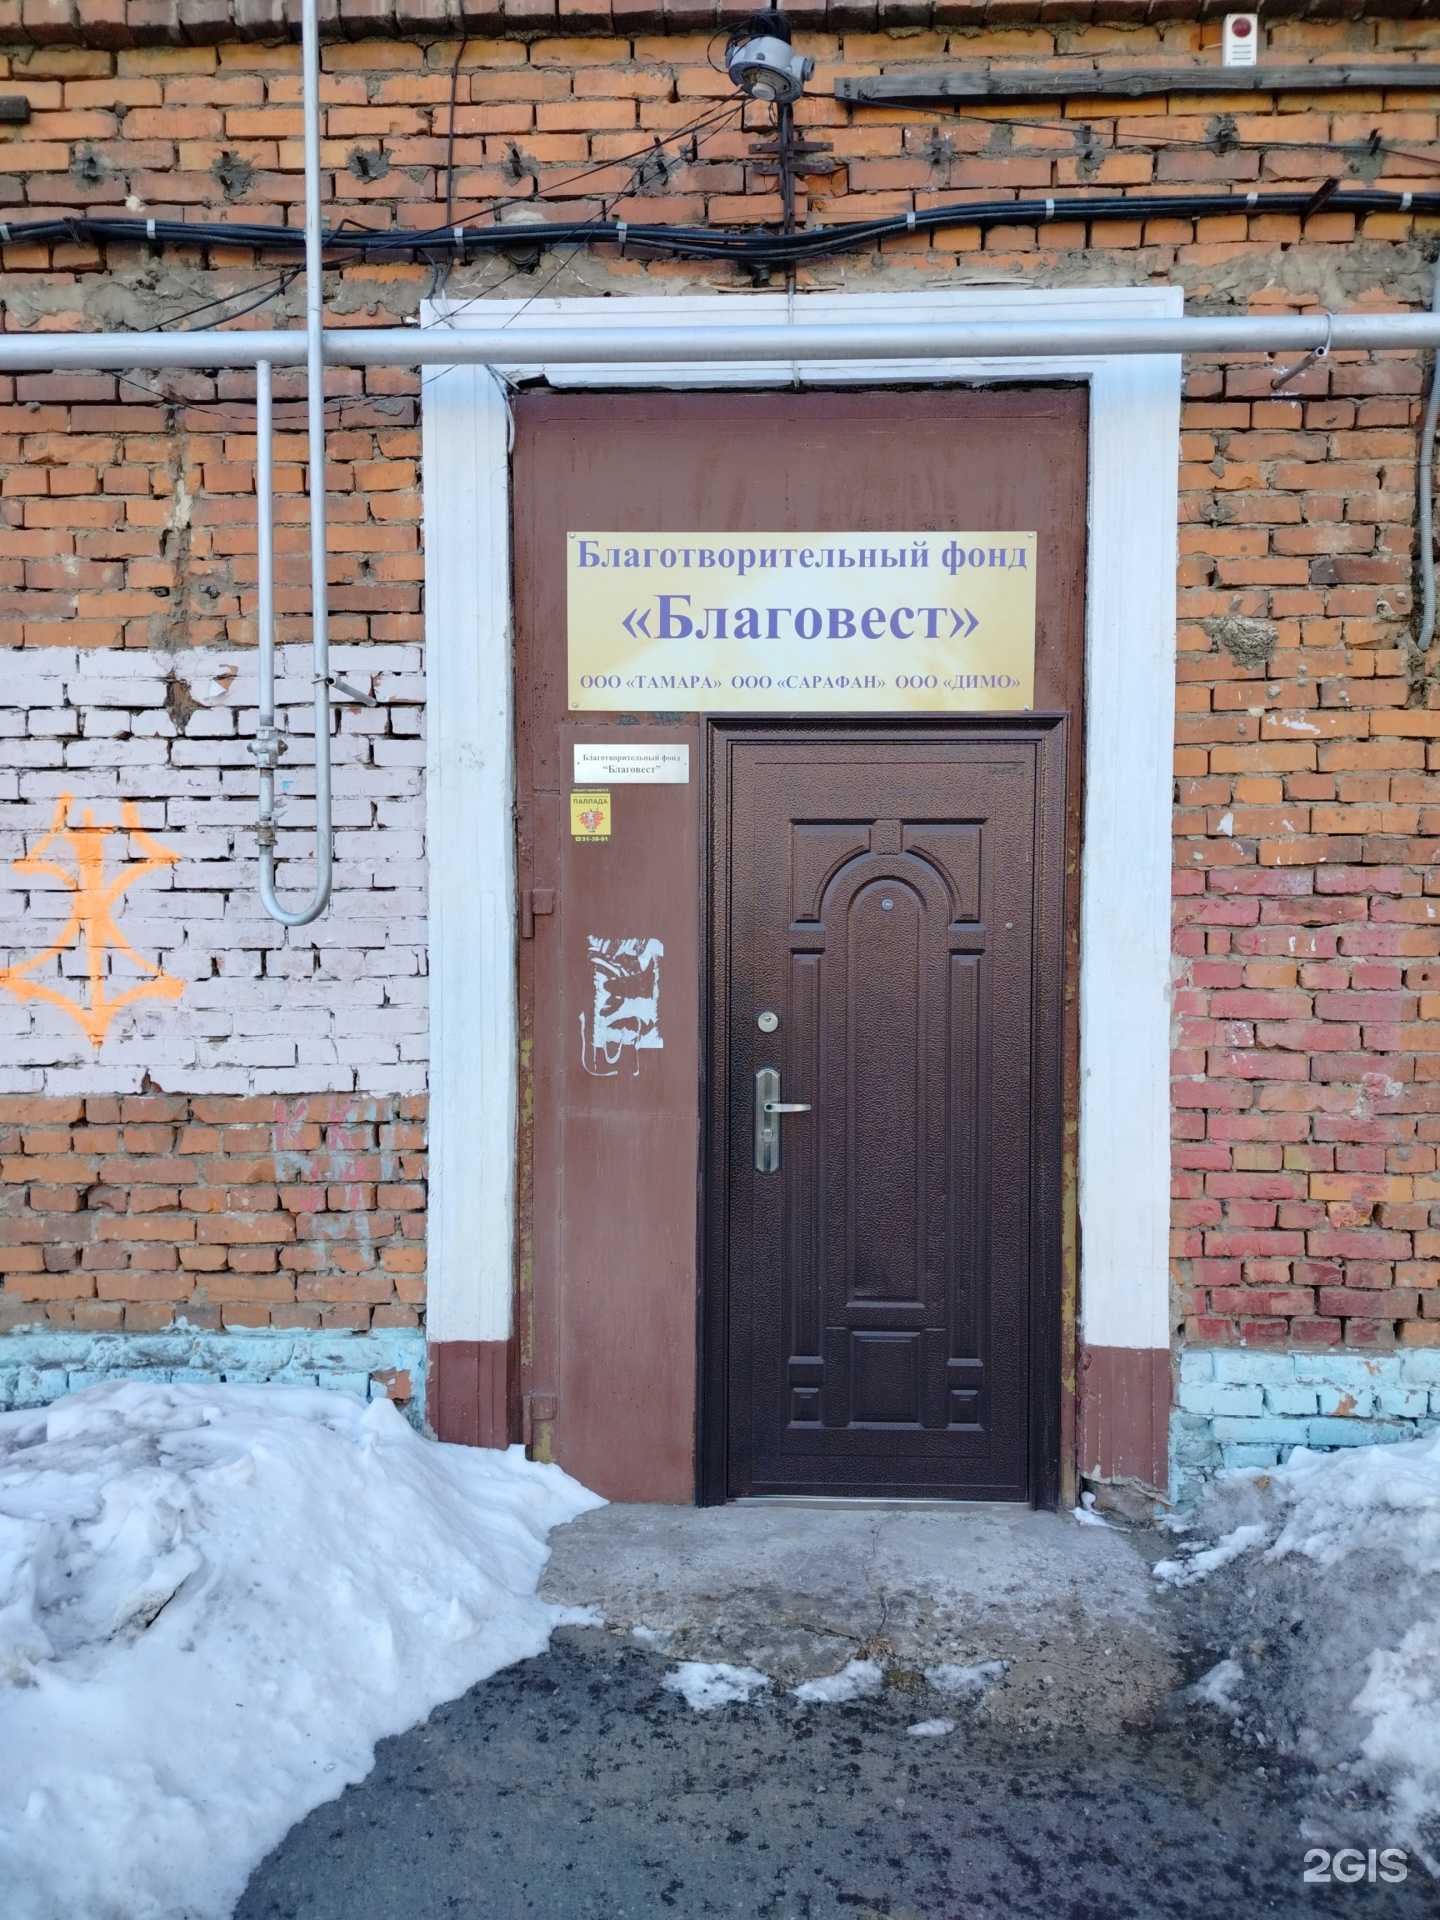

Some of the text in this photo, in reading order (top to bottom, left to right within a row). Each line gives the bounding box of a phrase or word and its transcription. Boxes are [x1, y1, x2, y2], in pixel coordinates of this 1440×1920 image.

[577, 541, 1028, 576] Благотворительный фонд
[622, 594, 980, 640] «Благовест»
[580, 674, 1021, 692] ООО «ТАМАРА» ООО «САРАФАН» ООО «ДИМО»
[582, 753, 681, 763] Благотворительный фонд
